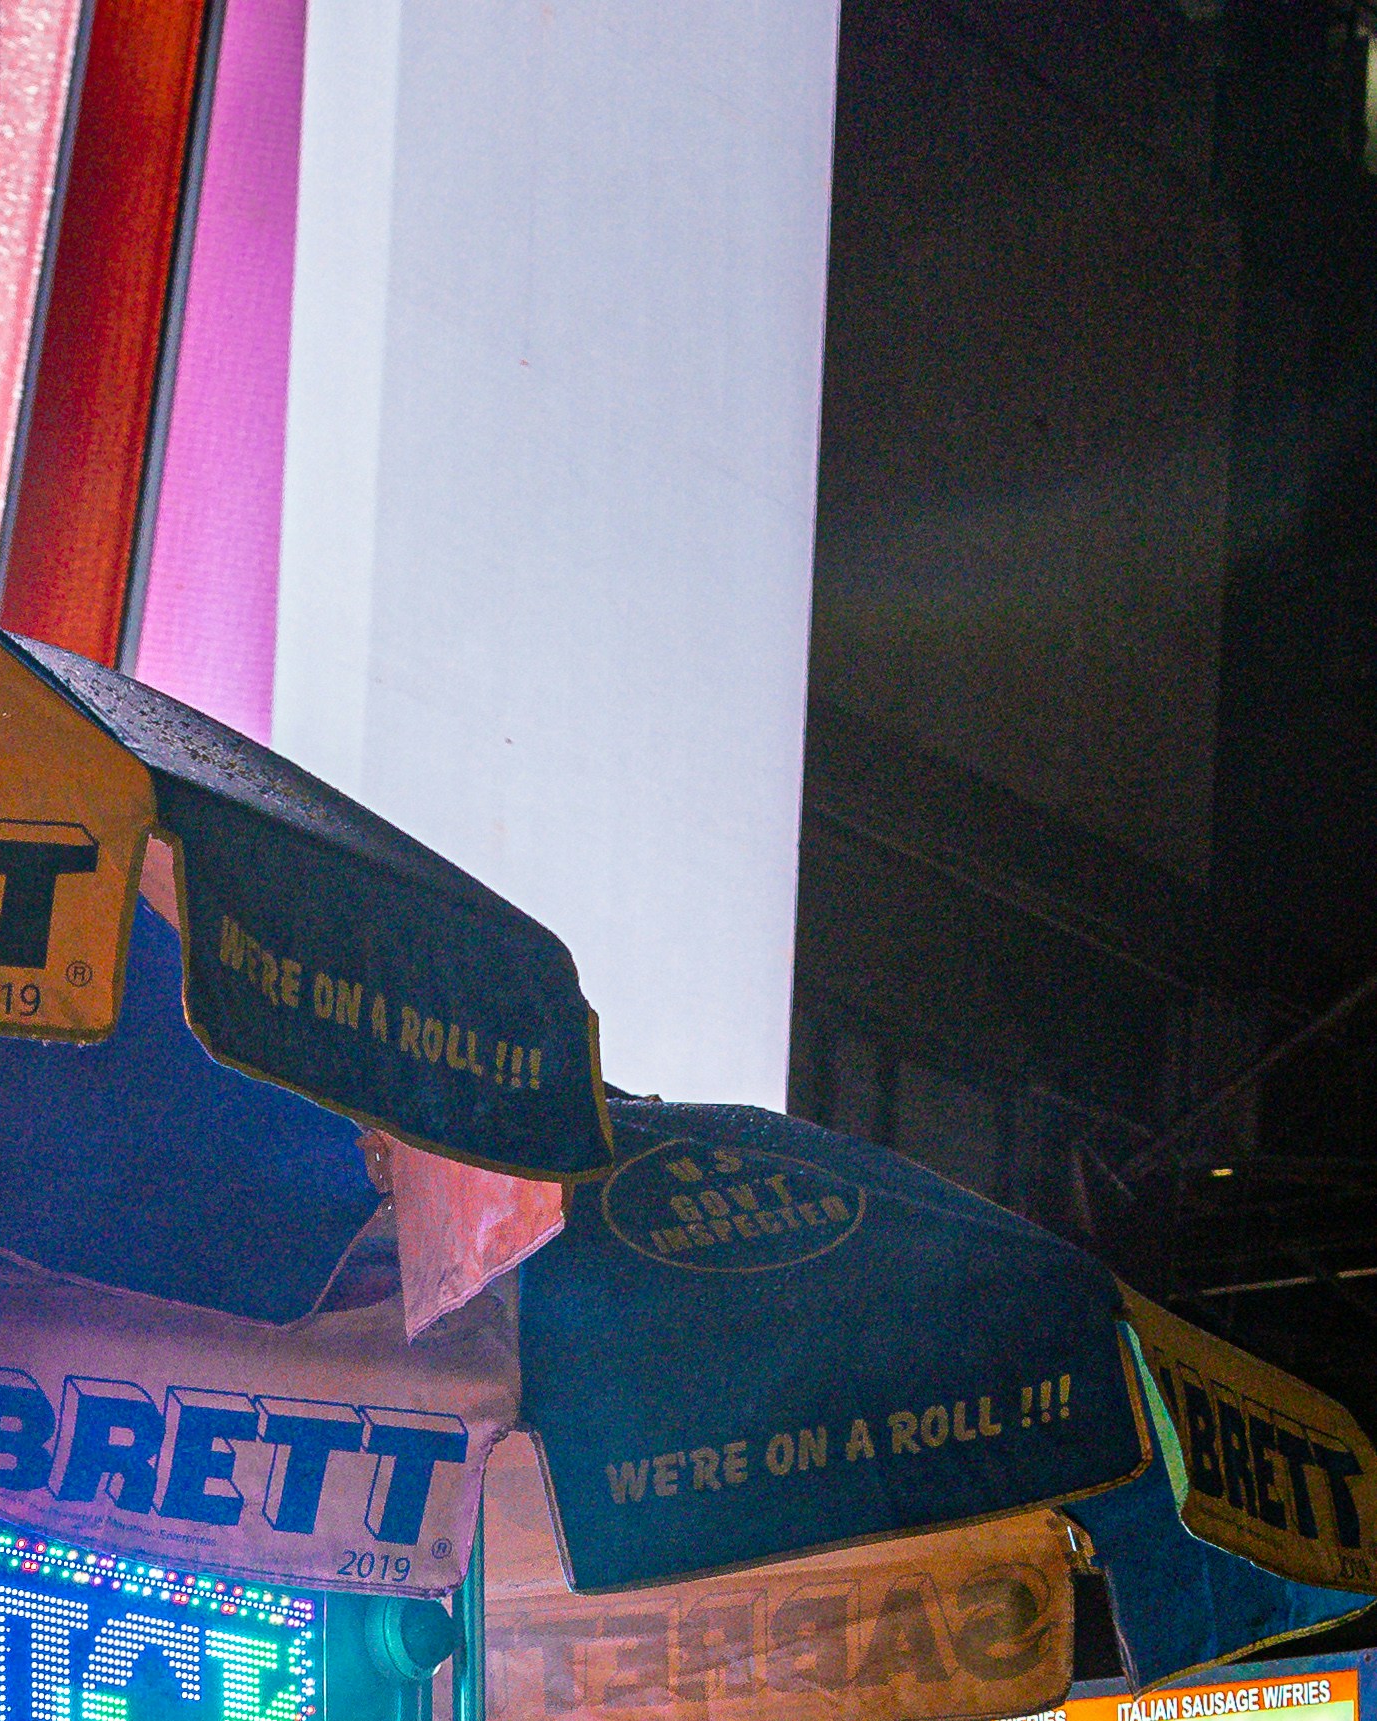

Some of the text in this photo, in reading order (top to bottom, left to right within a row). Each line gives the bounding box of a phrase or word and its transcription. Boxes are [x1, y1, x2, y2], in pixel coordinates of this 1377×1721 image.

[313, 971, 362, 1030] ON
[371, 992, 388, 1043] A
[399, 1005, 484, 1078] ROLL
[604, 1440, 747, 1505] WE'RE
[766, 1426, 827, 1476] ON
[846, 1419, 875, 1462] A
[887, 1396, 1002, 1455] ROLL
[337, 1551, 411, 1583] 2019
[1182, 1689, 1260, 1718] SAUSAGE
[1263, 1680, 1331, 1710] W/FRIES
